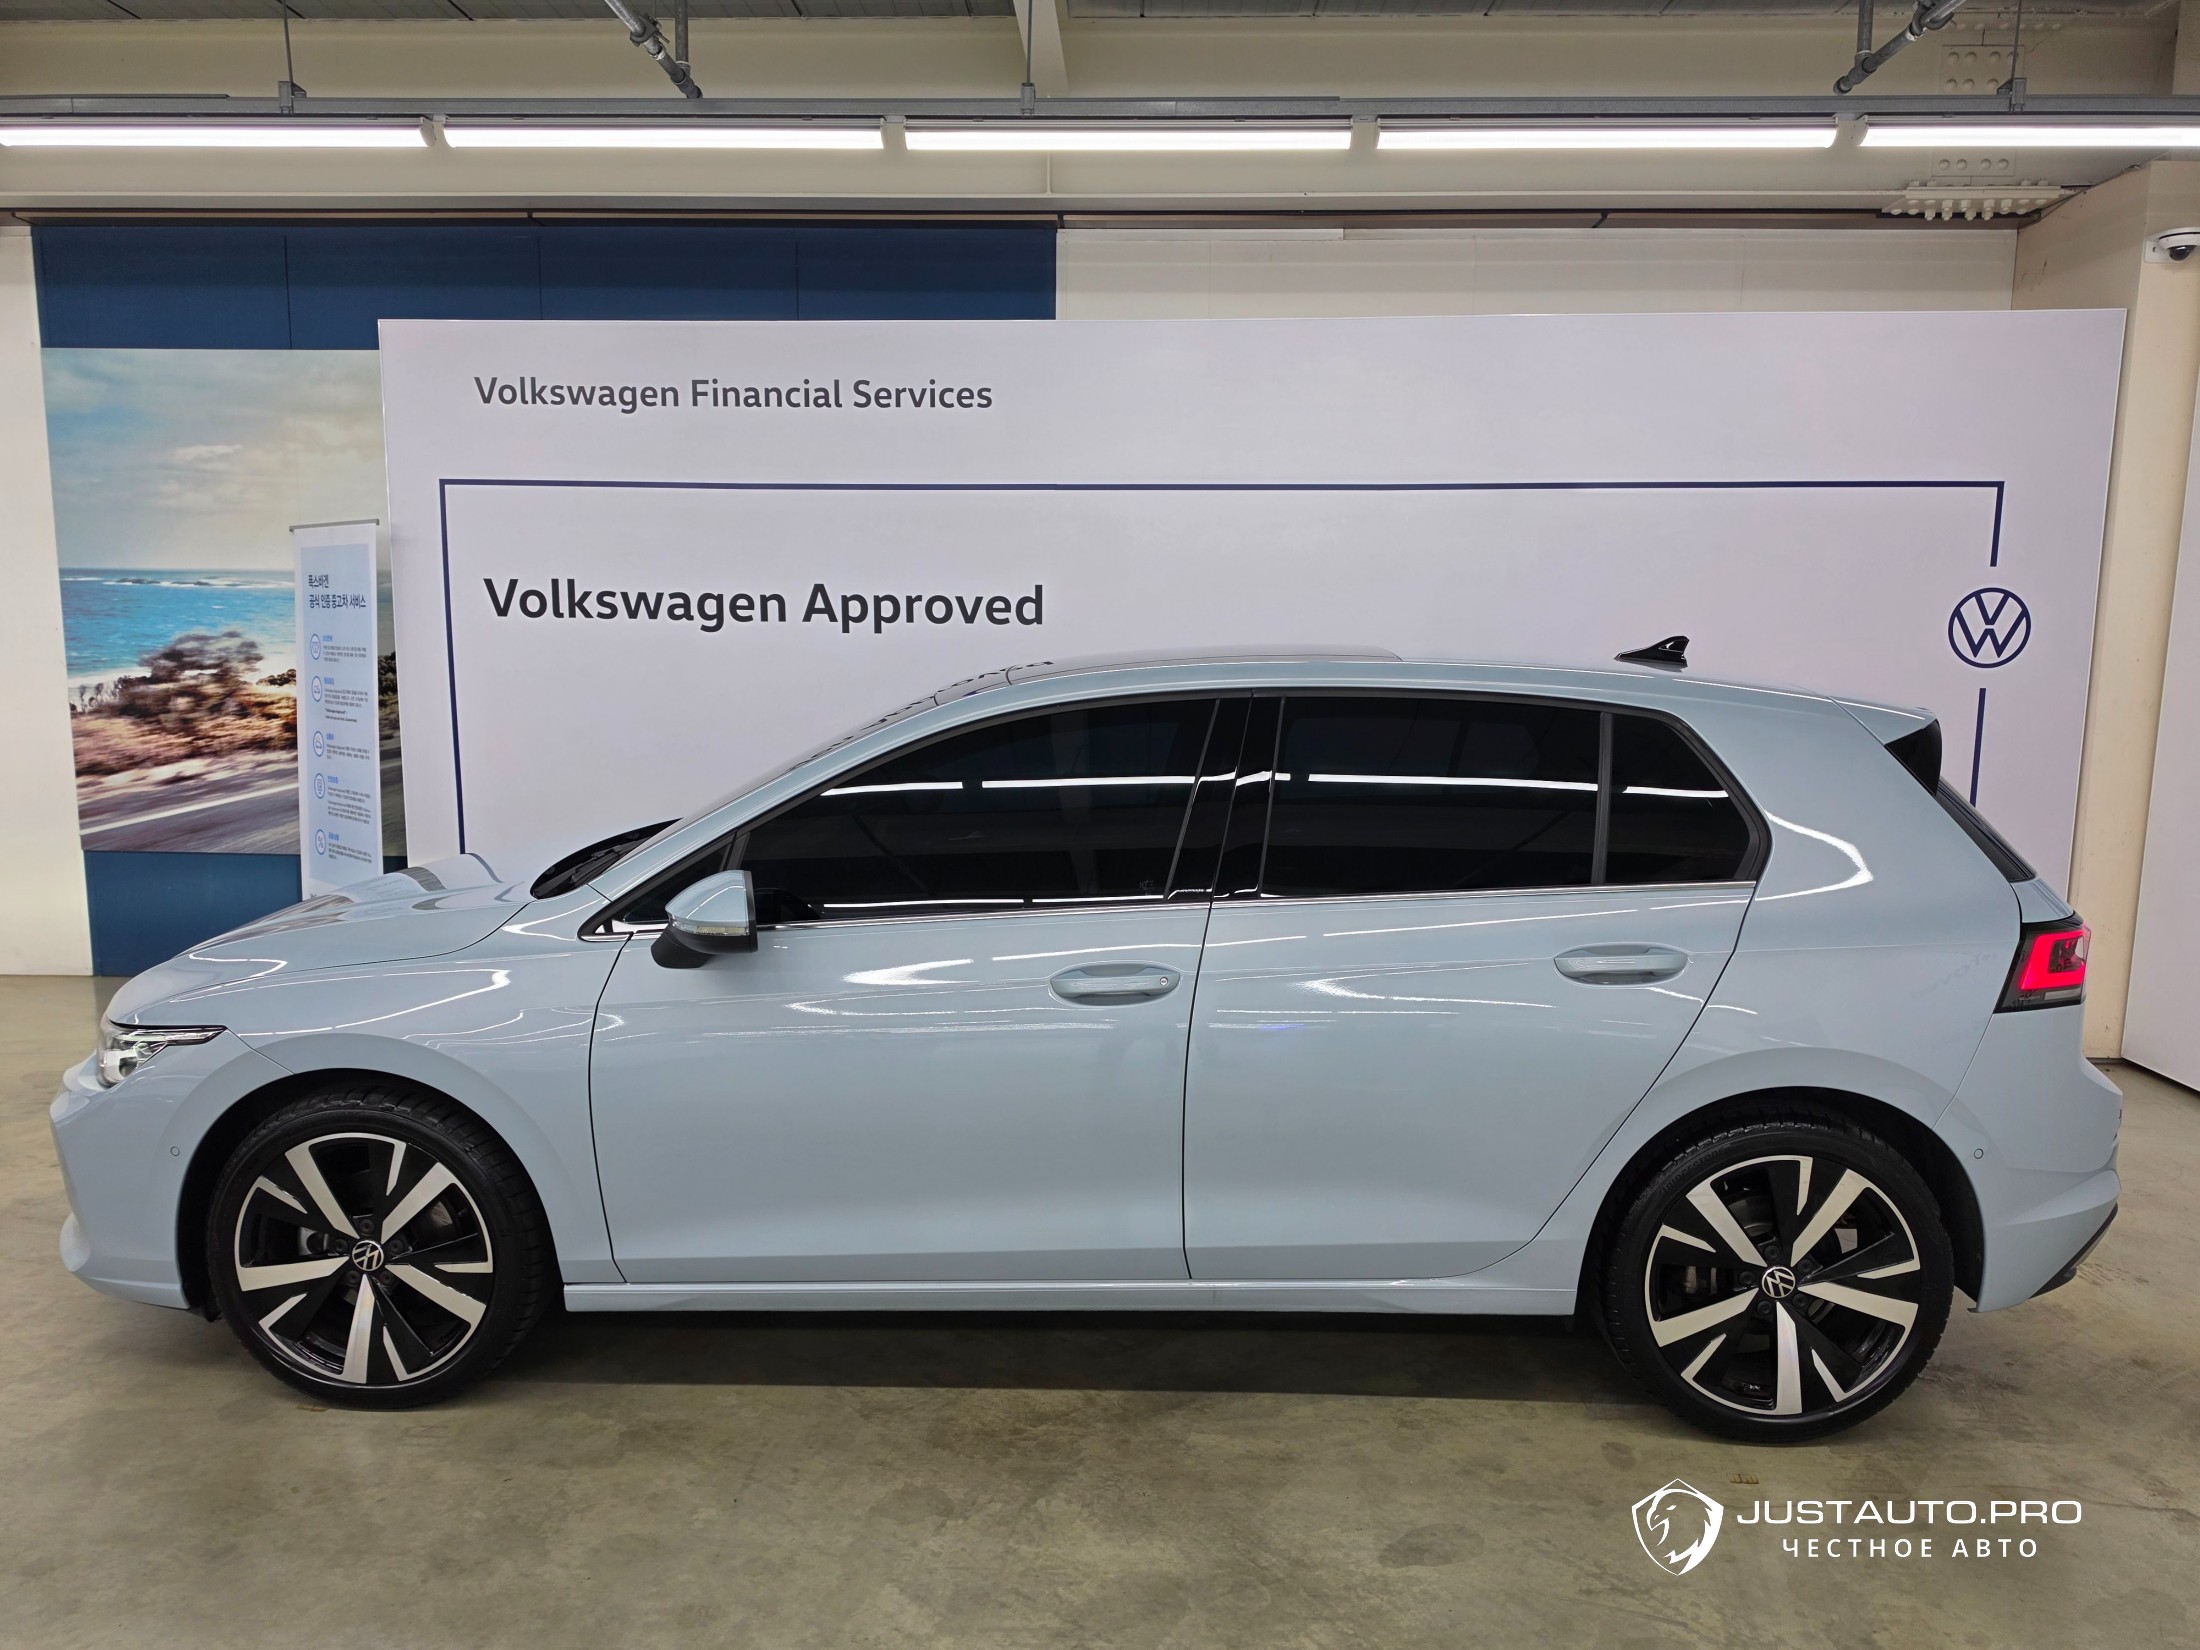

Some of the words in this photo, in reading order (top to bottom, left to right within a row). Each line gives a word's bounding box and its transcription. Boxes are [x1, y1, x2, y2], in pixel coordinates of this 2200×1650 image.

[474, 377, 678, 414] Volkswagen
[692, 379, 842, 408] Financial
[854, 379, 992, 408] Services
[308, 574, 329, 588] 폭스바겐
[309, 594, 320, 608] 공식
[321, 594, 331, 608] 인증
[331, 594, 348, 608] 중고차
[349, 594, 366, 609] 서비스
[483, 578, 786, 632] Volkswagen
[802, 584, 1042, 634] Approved
